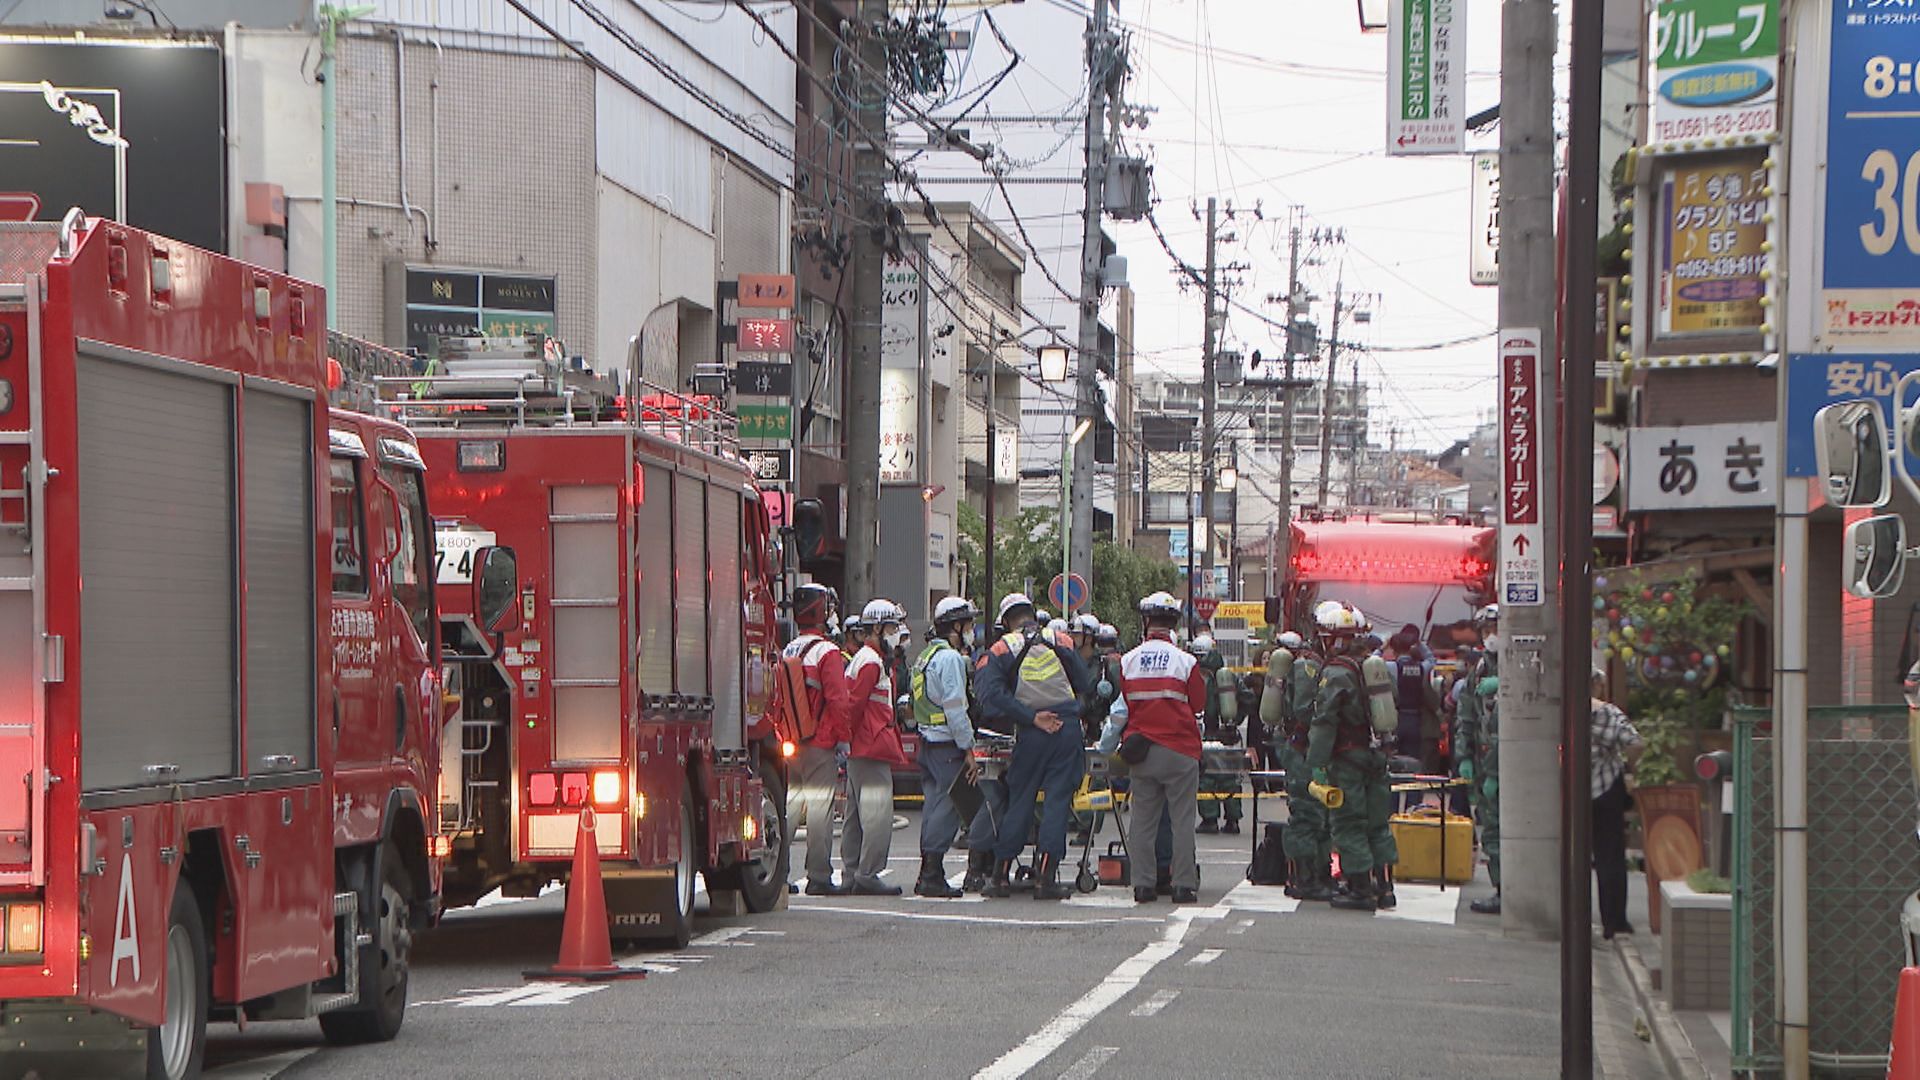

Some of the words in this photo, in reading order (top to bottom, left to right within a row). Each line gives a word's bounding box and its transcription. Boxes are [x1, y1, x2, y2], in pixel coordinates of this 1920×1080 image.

[1863, 55, 1920, 99] 8:
[1706, 173, 1743, 200] 今池
[1708, 230, 1737, 253] 5F
[746, 322, 776, 333] スナック
[1827, 360, 1901, 397] 安心
[741, 415, 787, 430] やすらぎ
[1659, 438, 1765, 496] あき
[1153, 652, 1170, 667] 119
[110, 852, 141, 987] A
